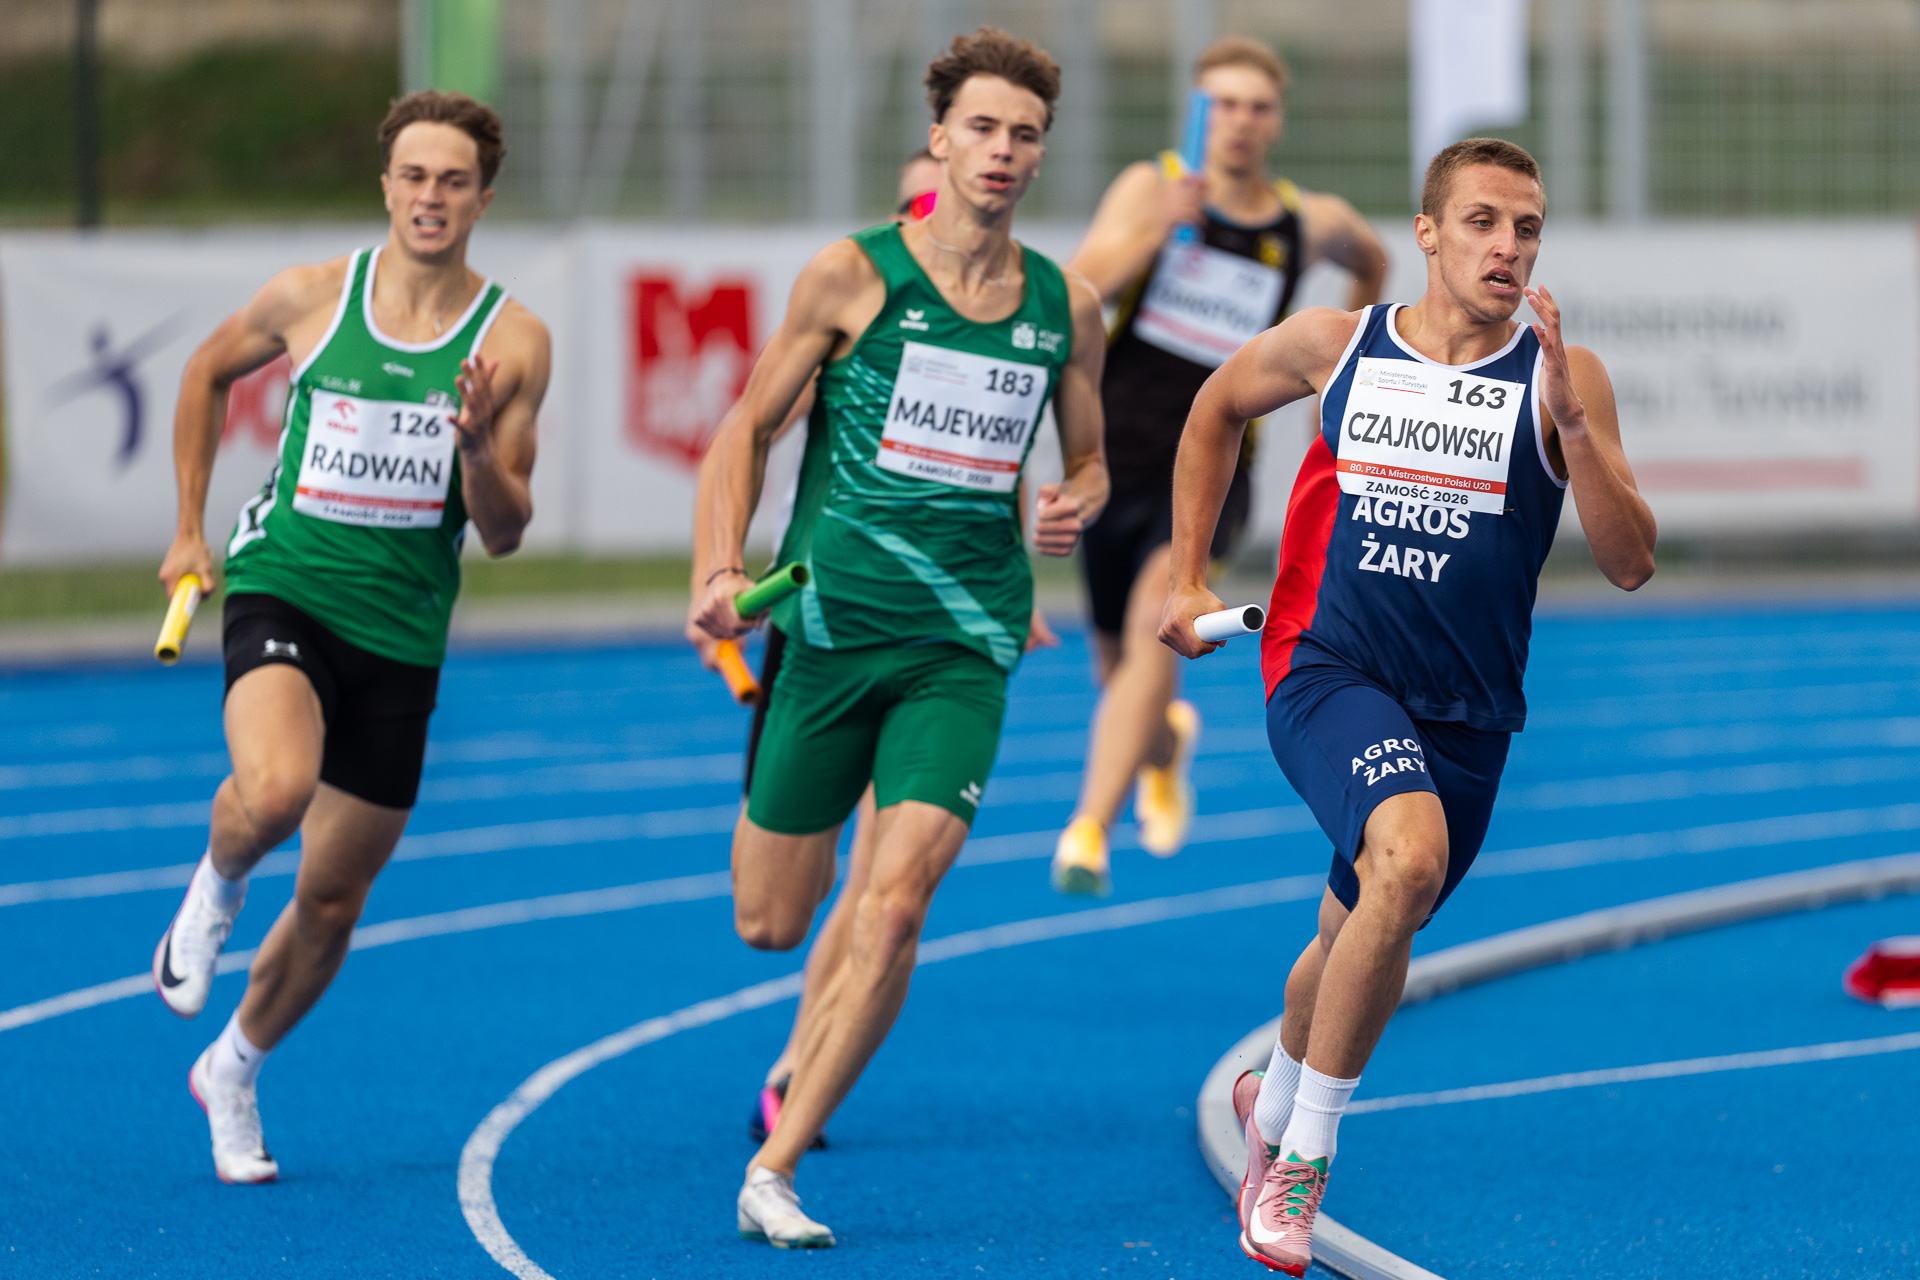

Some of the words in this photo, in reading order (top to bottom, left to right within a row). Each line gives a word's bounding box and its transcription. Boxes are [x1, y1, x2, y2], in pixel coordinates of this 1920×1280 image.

[985, 368, 1034, 397] 183
[1378, 376, 1397, 386] Sportu
[1402, 379, 1428, 389] Turystyki
[1380, 370, 1417, 381] Ministerstwo
[1447, 379, 1507, 410] 163
[391, 411, 441, 437] 126
[894, 397, 1026, 445] MAJEWSKI
[1348, 411, 1503, 462] CZAJKOWSKI
[310, 443, 442, 486] RADWAN
[1350, 463, 1363, 473] 80.
[1365, 465, 1386, 476] PZLA
[1388, 469, 1443, 484] Mistrzostwa
[1444, 477, 1472, 488] Polski
[1473, 481, 1491, 491] U20
[1366, 480, 1430, 500] ZAMOŚĆ
[1433, 490, 1469, 505] 2026
[1351, 496, 1471, 540] AGROS
[1358, 532, 1451, 583] ŻARY
[1363, 757, 1426, 786] ŻARY
